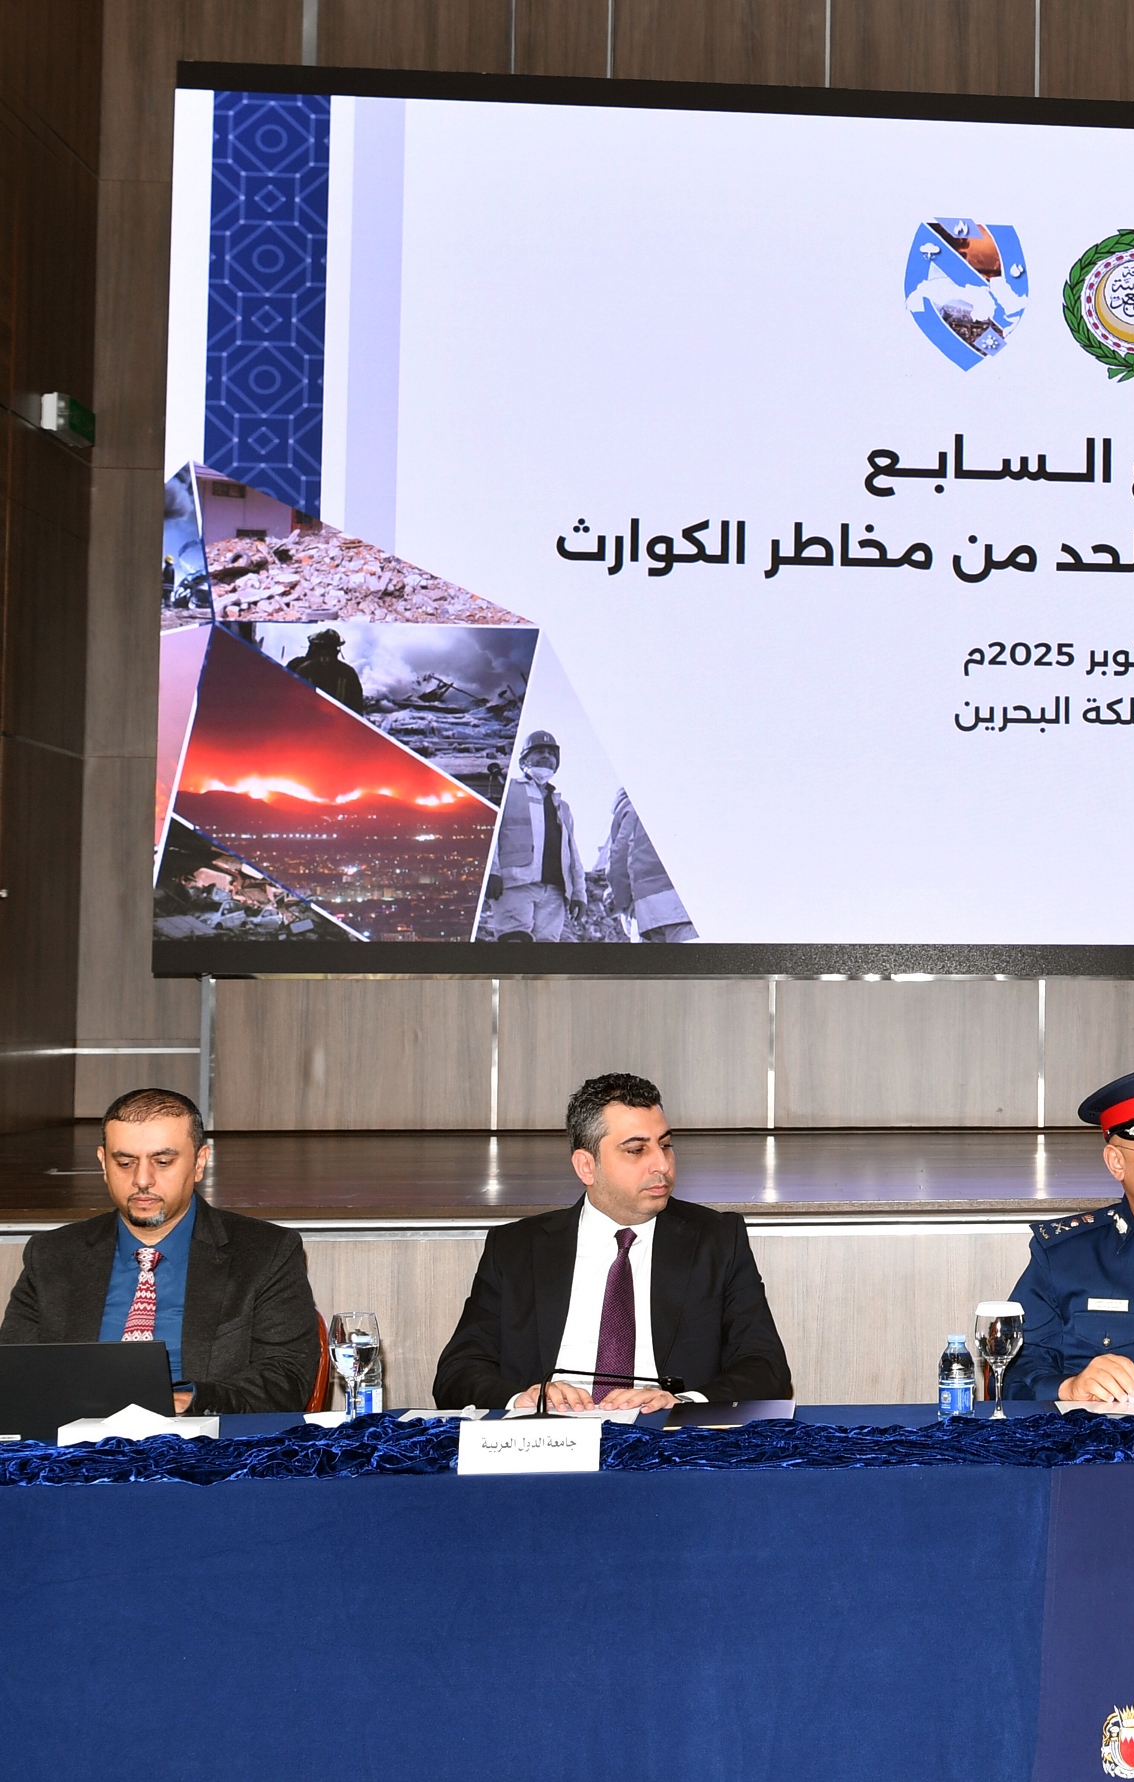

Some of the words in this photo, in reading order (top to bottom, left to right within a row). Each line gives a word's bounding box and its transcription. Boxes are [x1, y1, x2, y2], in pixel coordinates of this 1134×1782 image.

[864, 433, 1112, 498] السابع
[556, 517, 747, 578] الكوارث
[763, 521, 934, 580] مخاطر
[952, 534, 1039, 584] من
[963, 641, 1076, 677] 2025م
[953, 694, 1071, 734] البحرين
[481, 1436, 518, 1453] العربية
[517, 1436, 546, 1453] الدول
[546, 1436, 577, 1452] جامعة
